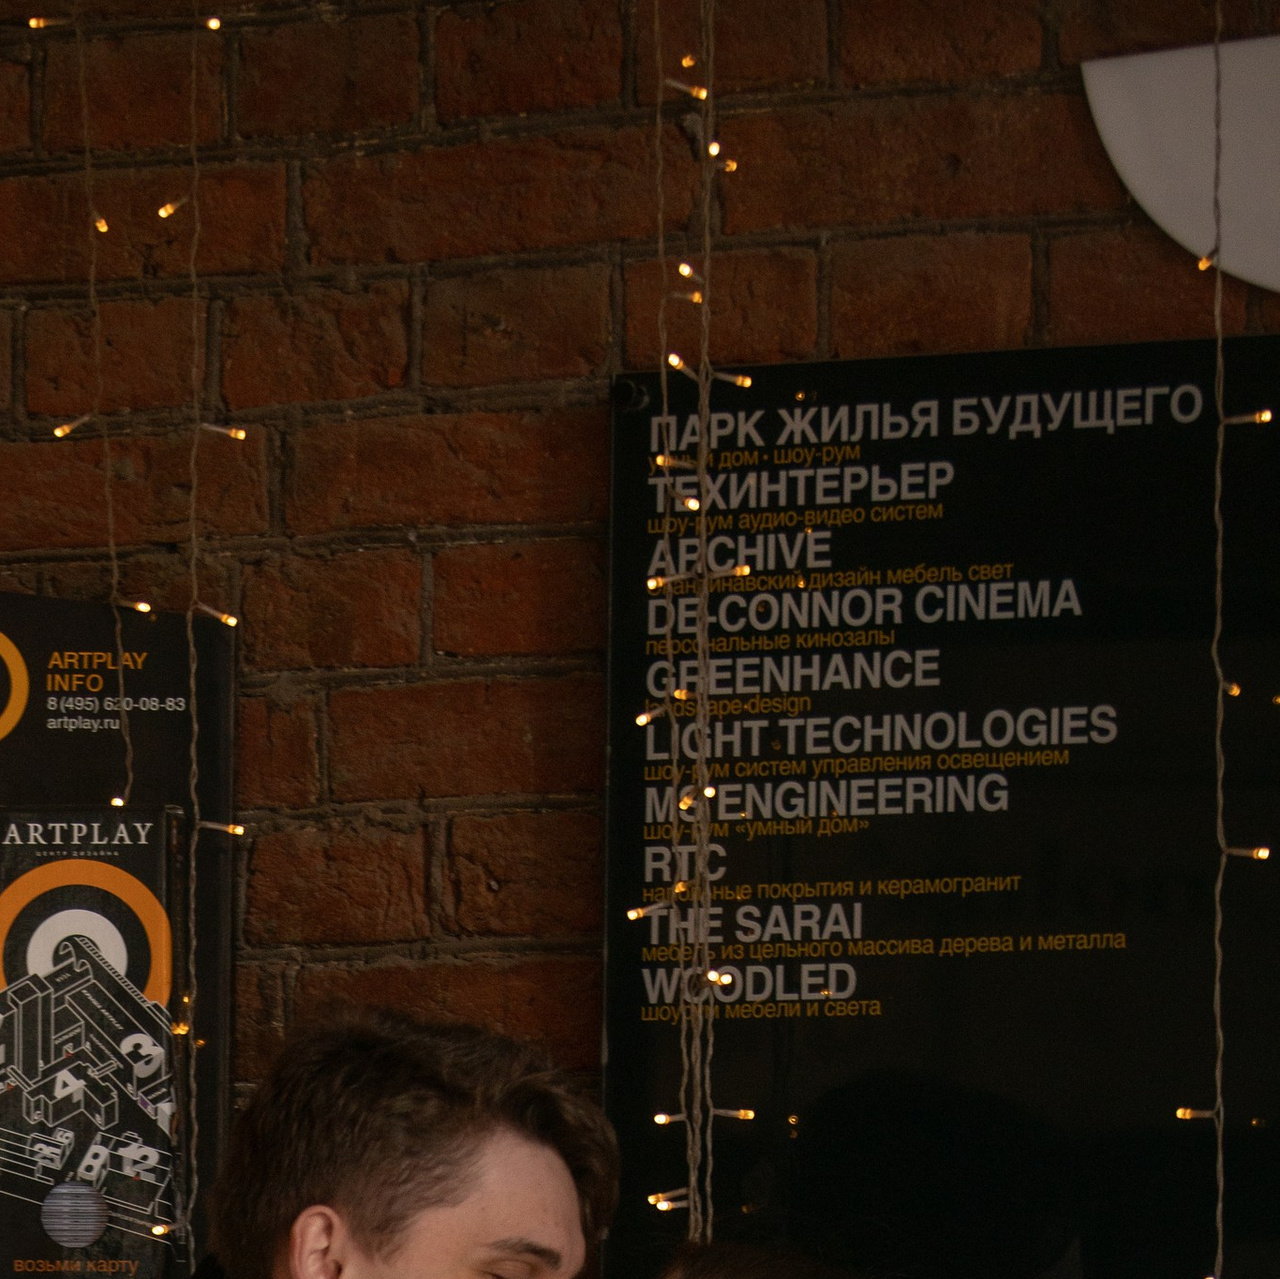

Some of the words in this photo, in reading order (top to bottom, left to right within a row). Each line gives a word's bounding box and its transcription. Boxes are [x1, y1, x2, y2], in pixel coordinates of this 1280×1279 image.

[650, 409, 766, 452] ПАРК
[776, 400, 939, 445] ЖИЛЬЯ
[952, 383, 1204, 440] БУДУЩЕГО
[720, 451, 760, 469] дом
[773, 445, 861, 467] шоу-рум
[647, 461, 955, 513] ТЕХИНТЕРЬЕР
[739, 507, 865, 531] аудио-видео
[871, 502, 945, 522] систем
[647, 531, 832, 576] ARCHIVE
[808, 566, 881, 592] дизайн
[886, 564, 963, 585] мебель
[968, 562, 1014, 581] свет
[647, 587, 903, 635] DE-CONNOR
[914, 578, 1083, 625] CINEMA
[796, 630, 895, 650] кинозалы
[47, 651, 148, 670] ARTPLAY
[646, 649, 941, 698] GREENHANCE
[45, 674, 104, 692] INFO
[103, 697, 186, 711] 620-08-83
[748, 694, 811, 717] design
[47, 715, 120, 733] artplay.ru
[646, 719, 769, 760] LIGHT
[778, 704, 1118, 755] TECHNOLOGIES
[734, 759, 806, 778] систем
[812, 755, 931, 779] управления
[936, 749, 1069, 770] освещением
[717, 773, 1008, 820] ENGINEERING
[1, 823, 154, 845] ARTPLAY
[736, 817, 812, 841] «умный
[817, 816, 870, 836] дом»
[644, 844, 727, 882] RTC
[757, 879, 853, 903] покрытия
[859, 879, 871, 896] и
[877, 875, 1022, 899] керамогранит
[643, 906, 723, 945] THE
[735, 902, 862, 944] SARAI
[722, 943, 744, 959] из
[748, 939, 842, 961] цельного
[849, 936, 934, 956] массива
[939, 934, 1014, 957] дерева
[1019, 934, 1032, 950] и
[1037, 931, 1126, 950] металла
[642, 963, 857, 1004] WOODLED
[725, 1000, 800, 1019] мебели
[807, 1001, 819, 1017] и
[824, 999, 882, 1017] света
[13, 1259, 81, 1273] возьми
[87, 1259, 139, 1277] карту
